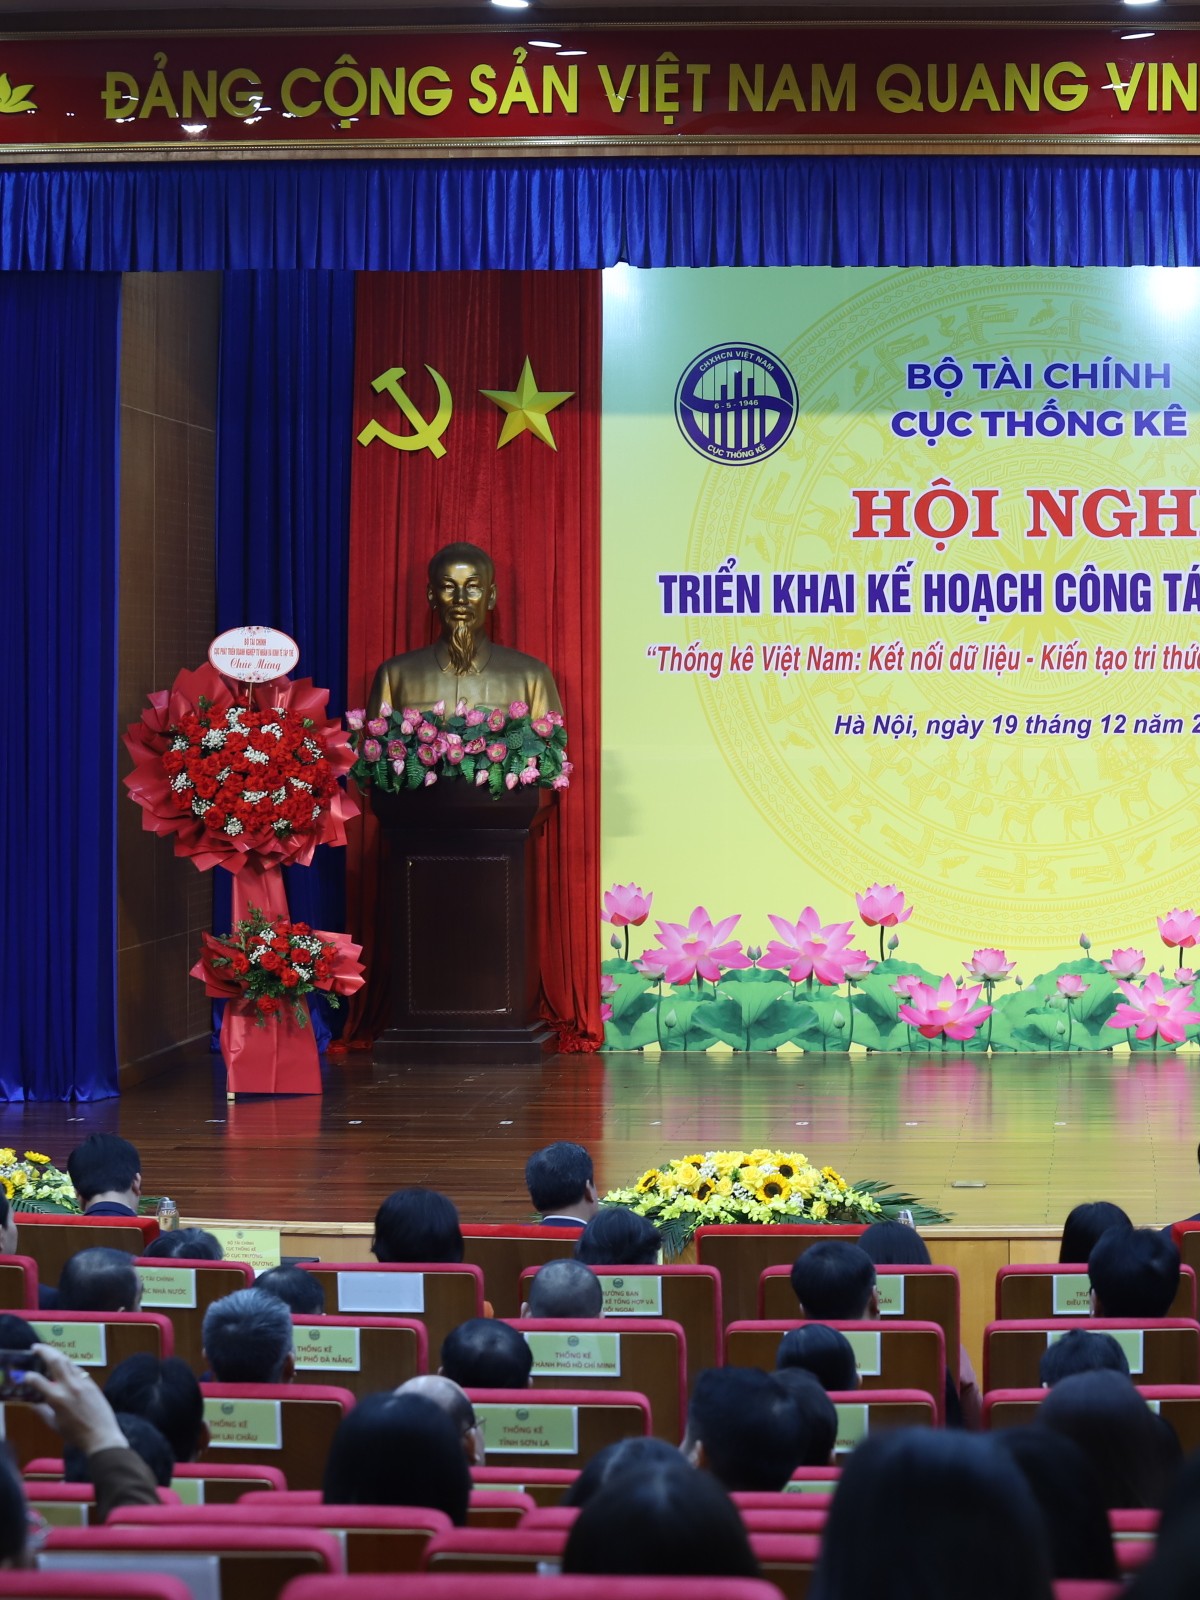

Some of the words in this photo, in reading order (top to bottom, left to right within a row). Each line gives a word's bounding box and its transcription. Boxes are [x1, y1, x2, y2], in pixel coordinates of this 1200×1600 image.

[101, 52, 264, 119] ĐẢNG
[281, 54, 453, 128] CỘNG
[469, 47, 578, 114] SẢN
[598, 52, 710, 124] VIỆT
[729, 64, 855, 112] NAM
[877, 62, 1089, 113] QUANG
[699, 351, 733, 372] CHXHCN
[735, 350, 755, 360] VIỆT
[755, 356, 775, 372] NAM
[908, 356, 963, 398] BỘ
[973, 357, 1031, 388] TÀI
[1044, 356, 1170, 389] CHÍNH
[892, 411, 973, 447] CỤC
[981, 398, 1123, 437] THỐNG
[1134, 403, 1187, 436] KÊ
[707, 444, 725, 456] CỤC
[726, 447, 755, 459] THỐNG
[755, 443, 767, 455] KÊ
[852, 478, 999, 551] HỘI
[659, 558, 760, 613] TRIỂN
[774, 574, 854, 613] KHAI
[868, 561, 913, 612] KẾ
[925, 573, 1041, 621] HOẠCH
[1056, 565, 1151, 612] CÔNG
[649, 642, 723, 678] “Thống
[730, 646, 754, 671] kê
[763, 646, 801, 676] Việt
[807, 646, 862, 671] Nam:
[869, 642, 905, 671] Kết
[911, 642, 944, 671] nối
[949, 645, 978, 671] dữ
[983, 645, 1020, 676] liệu
[1041, 642, 1087, 670] Kiến
[1096, 646, 1128, 676] tạo
[1134, 645, 1156, 670] tri
[835, 715, 864, 734] Hà
[873, 715, 917, 739] Nội,
[927, 715, 984, 739] ngày
[993, 715, 1017, 734] 19
[1026, 714, 1091, 739] tháng
[1101, 715, 1126, 733] 12
[1134, 714, 1183, 733] năm
[297, 1344, 323, 1353] THỐNG
[324, 1344, 333, 1353] KÊ
[303, 1355, 319, 1363] PHỐ
[555, 1350, 581, 1359] THỐNG
[583, 1351, 592, 1359] KÊ
[556, 1360, 572, 1368] PHỐ
[597, 1361, 617, 1369] MINH
[503, 1425, 532, 1434] THỐNG
[533, 1425, 544, 1434] KÊ
[540, 1439, 550, 1447] LA
